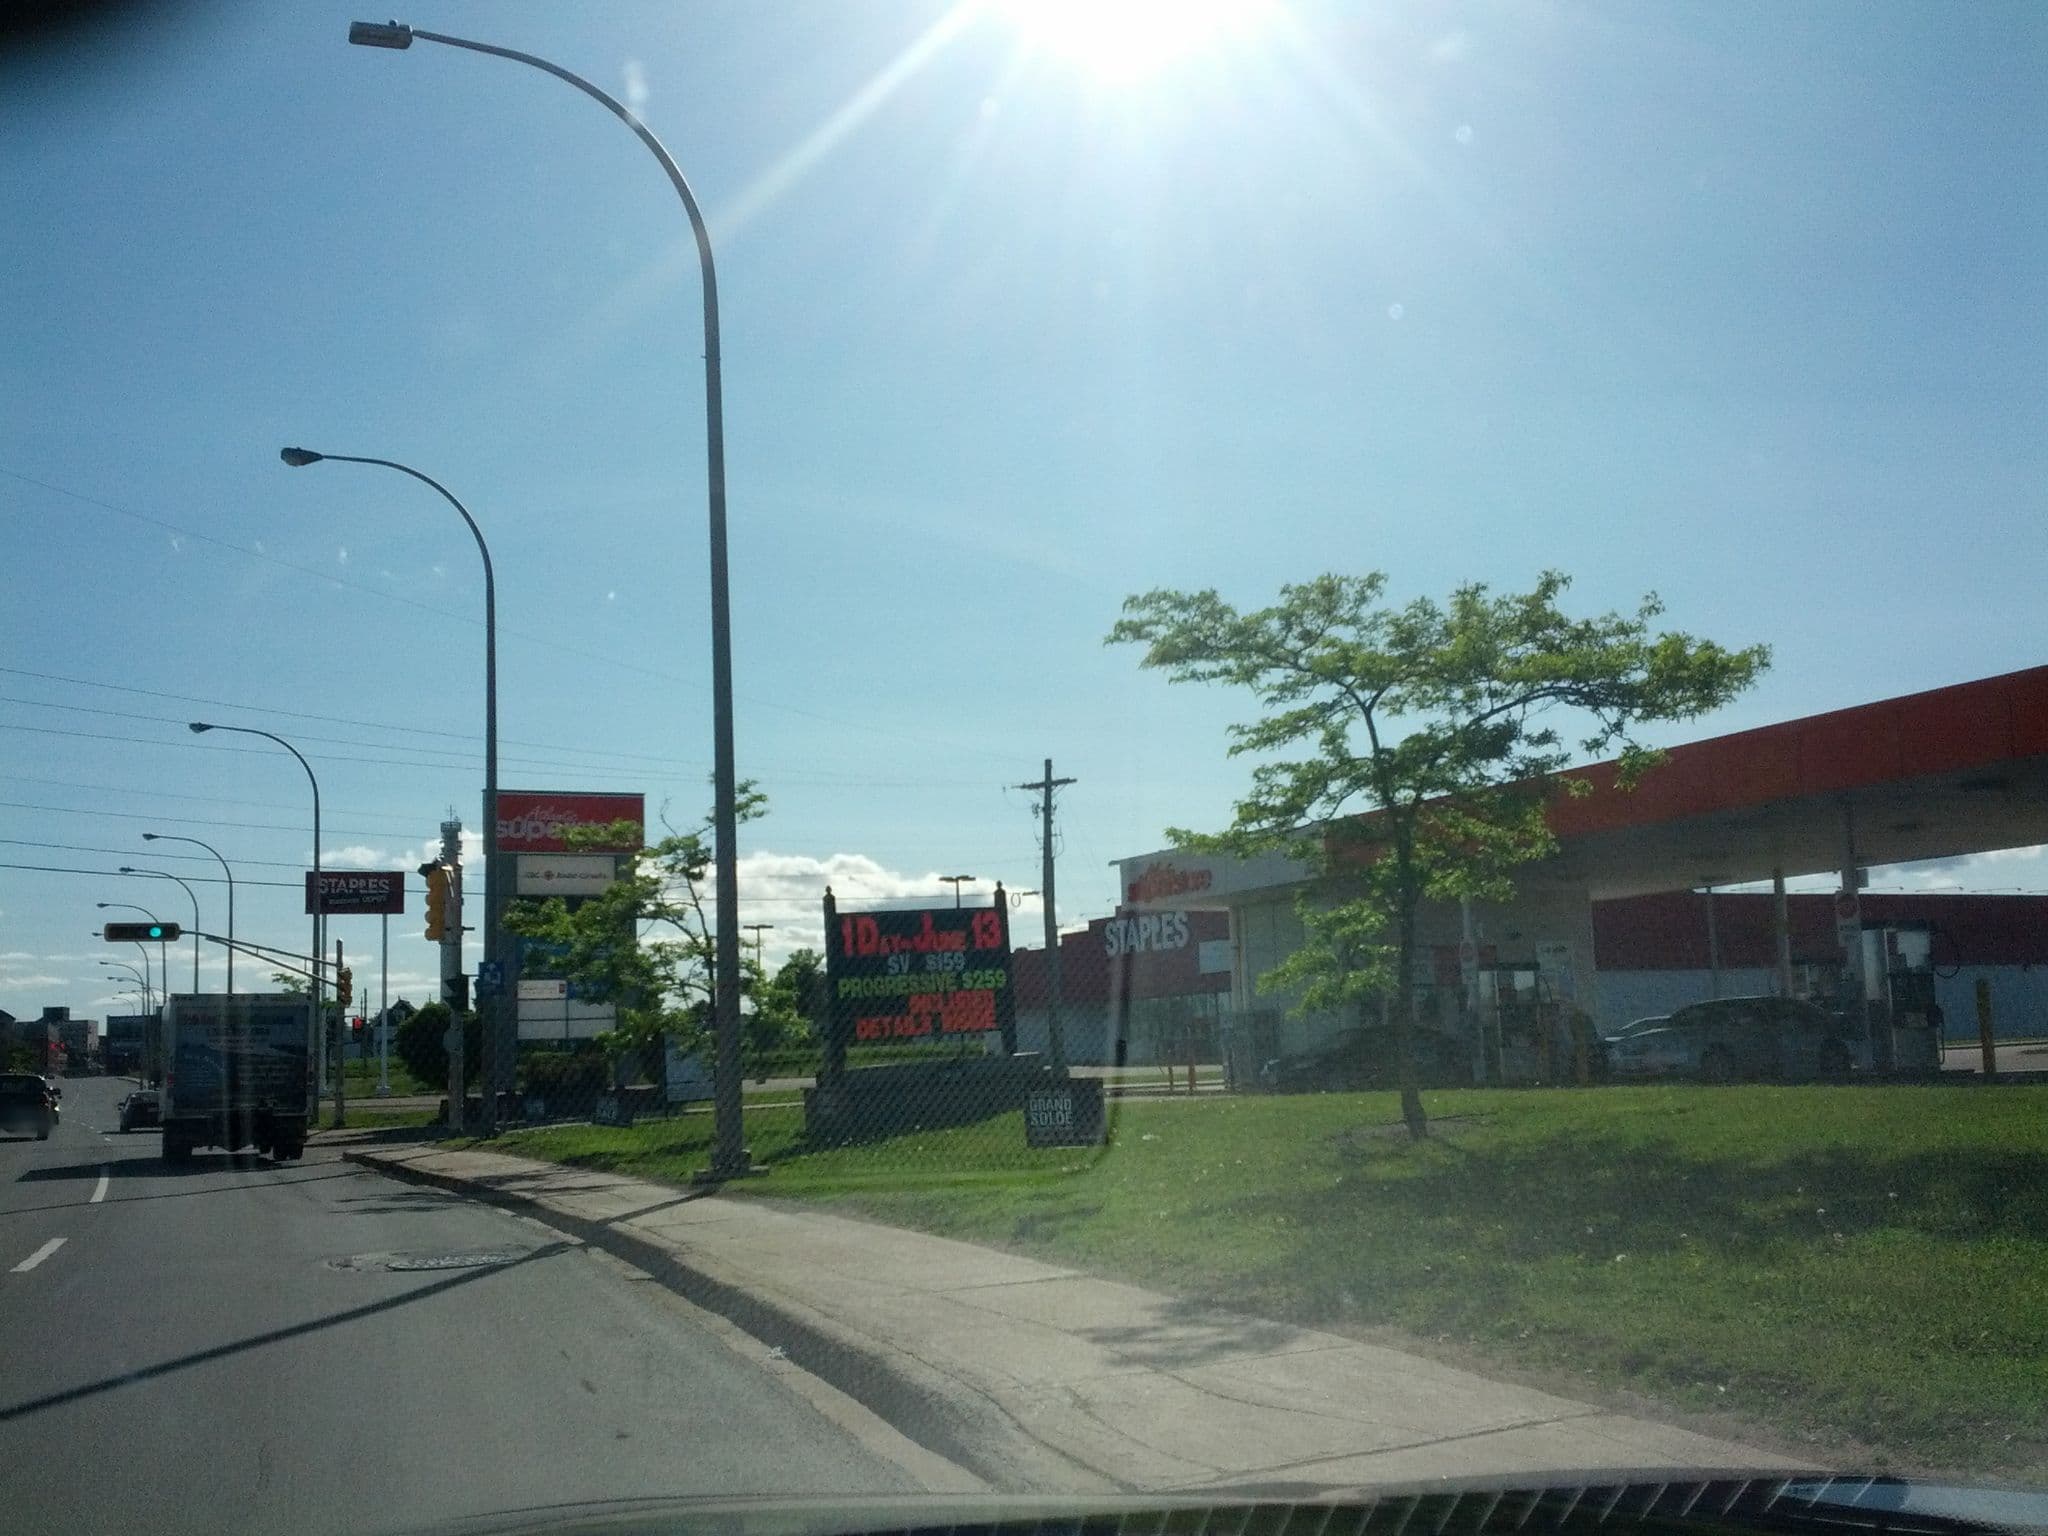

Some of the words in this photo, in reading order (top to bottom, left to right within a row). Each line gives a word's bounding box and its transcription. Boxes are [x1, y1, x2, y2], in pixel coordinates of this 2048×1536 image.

[319, 878, 391, 894] STAPLES
[1104, 911, 1190, 957] STAPLES
[888, 953, 911, 975] SV
[838, 972, 958, 999] PROGRESSIVE
[961, 968, 1007, 990] $259
[1029, 1098, 1072, 1111] GRAND
[1030, 1111, 1074, 1126] SOLDE
